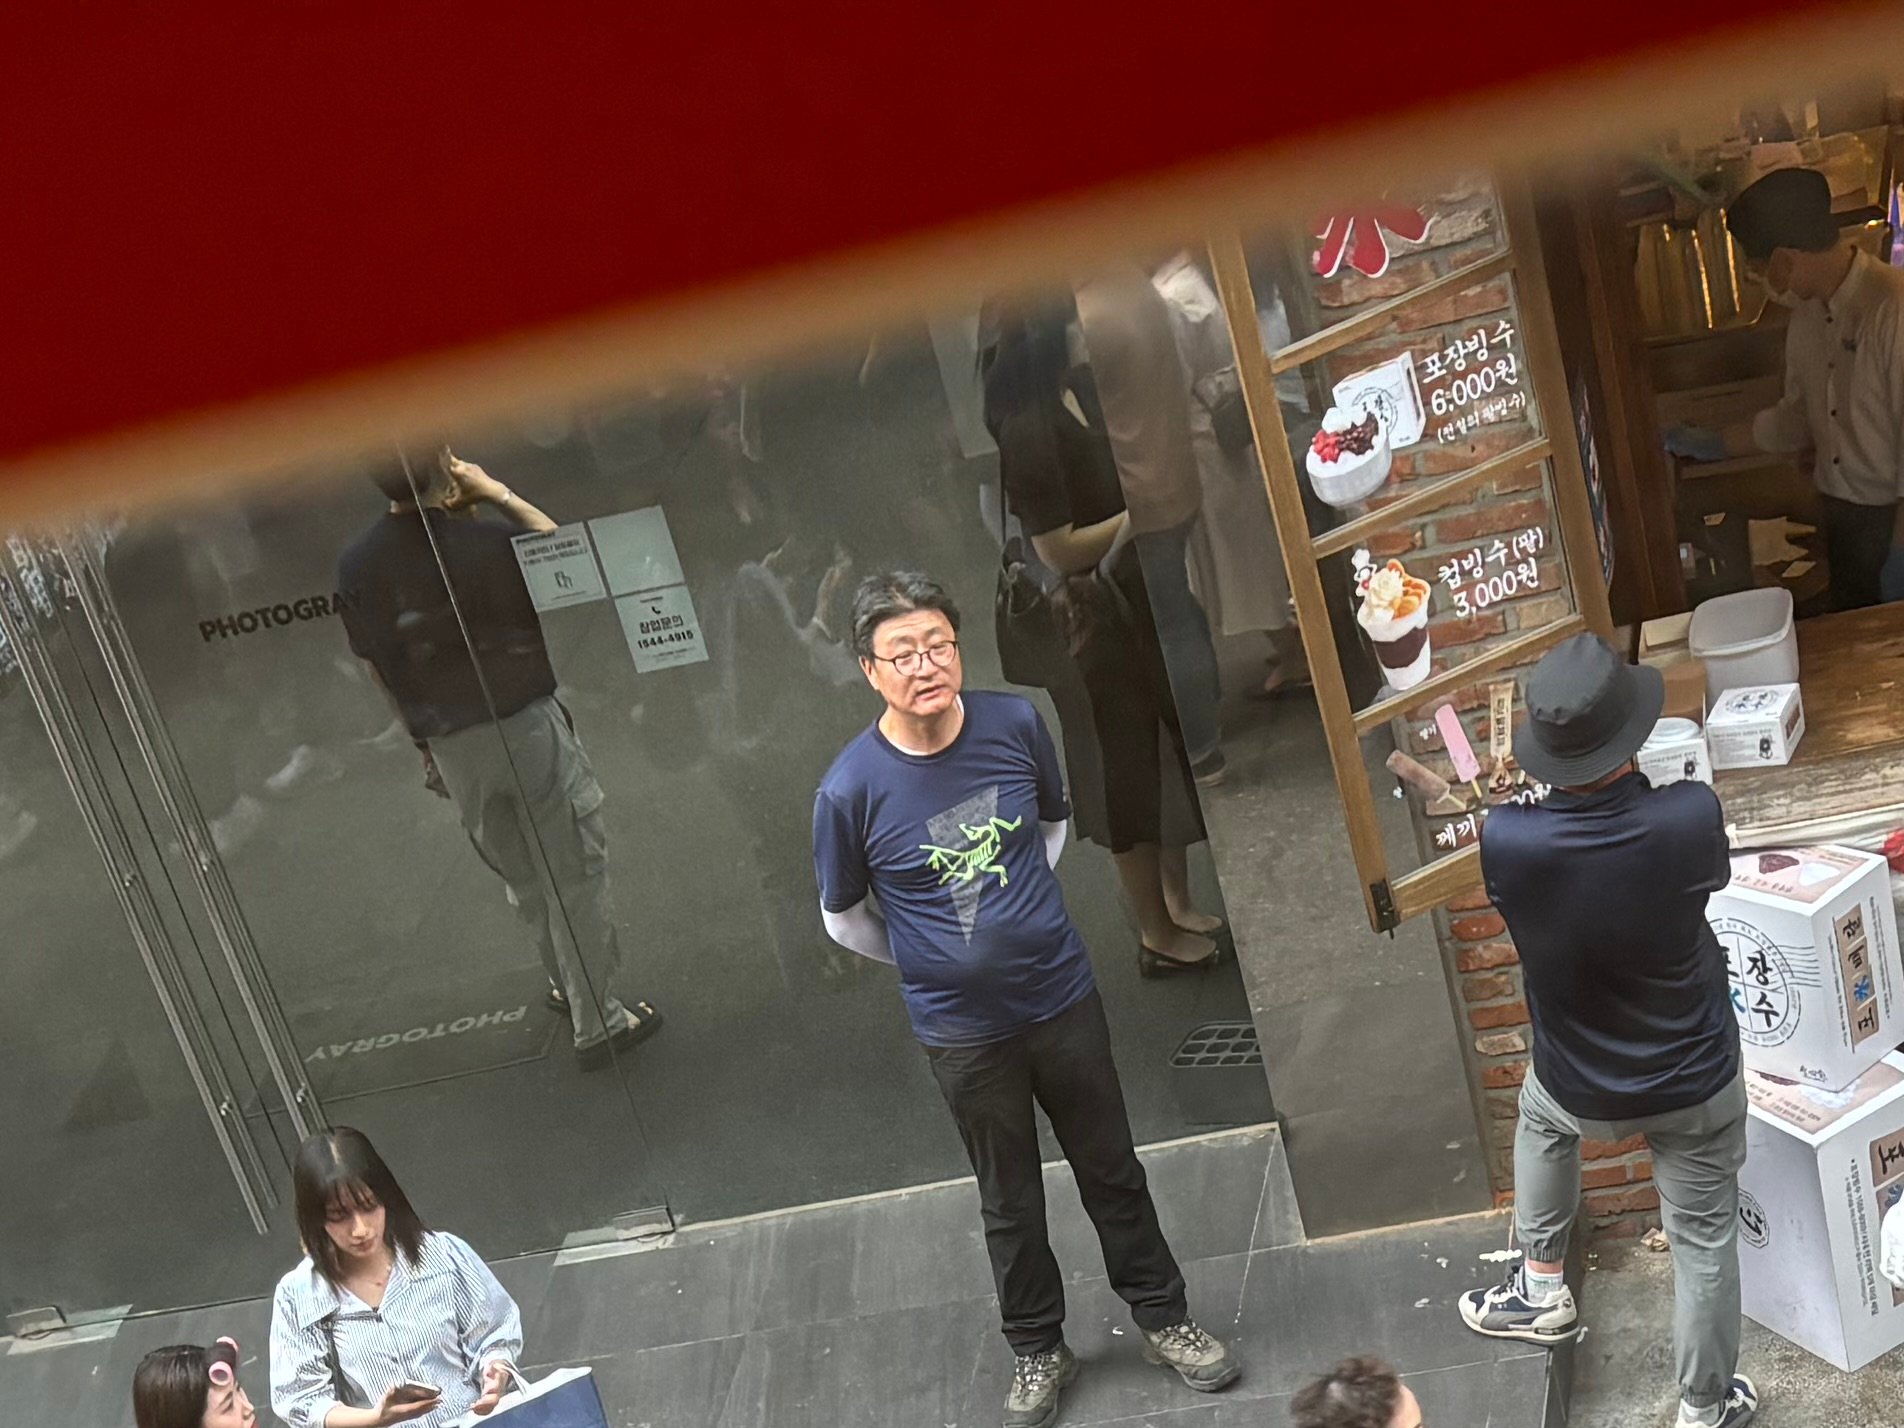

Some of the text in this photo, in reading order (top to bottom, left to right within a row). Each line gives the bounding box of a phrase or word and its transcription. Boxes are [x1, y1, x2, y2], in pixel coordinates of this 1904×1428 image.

[1423, 320, 1514, 383] 포장빙수
[1431, 353, 1518, 415] 6,000원
[1453, 557, 1539, 618] 3,000원
